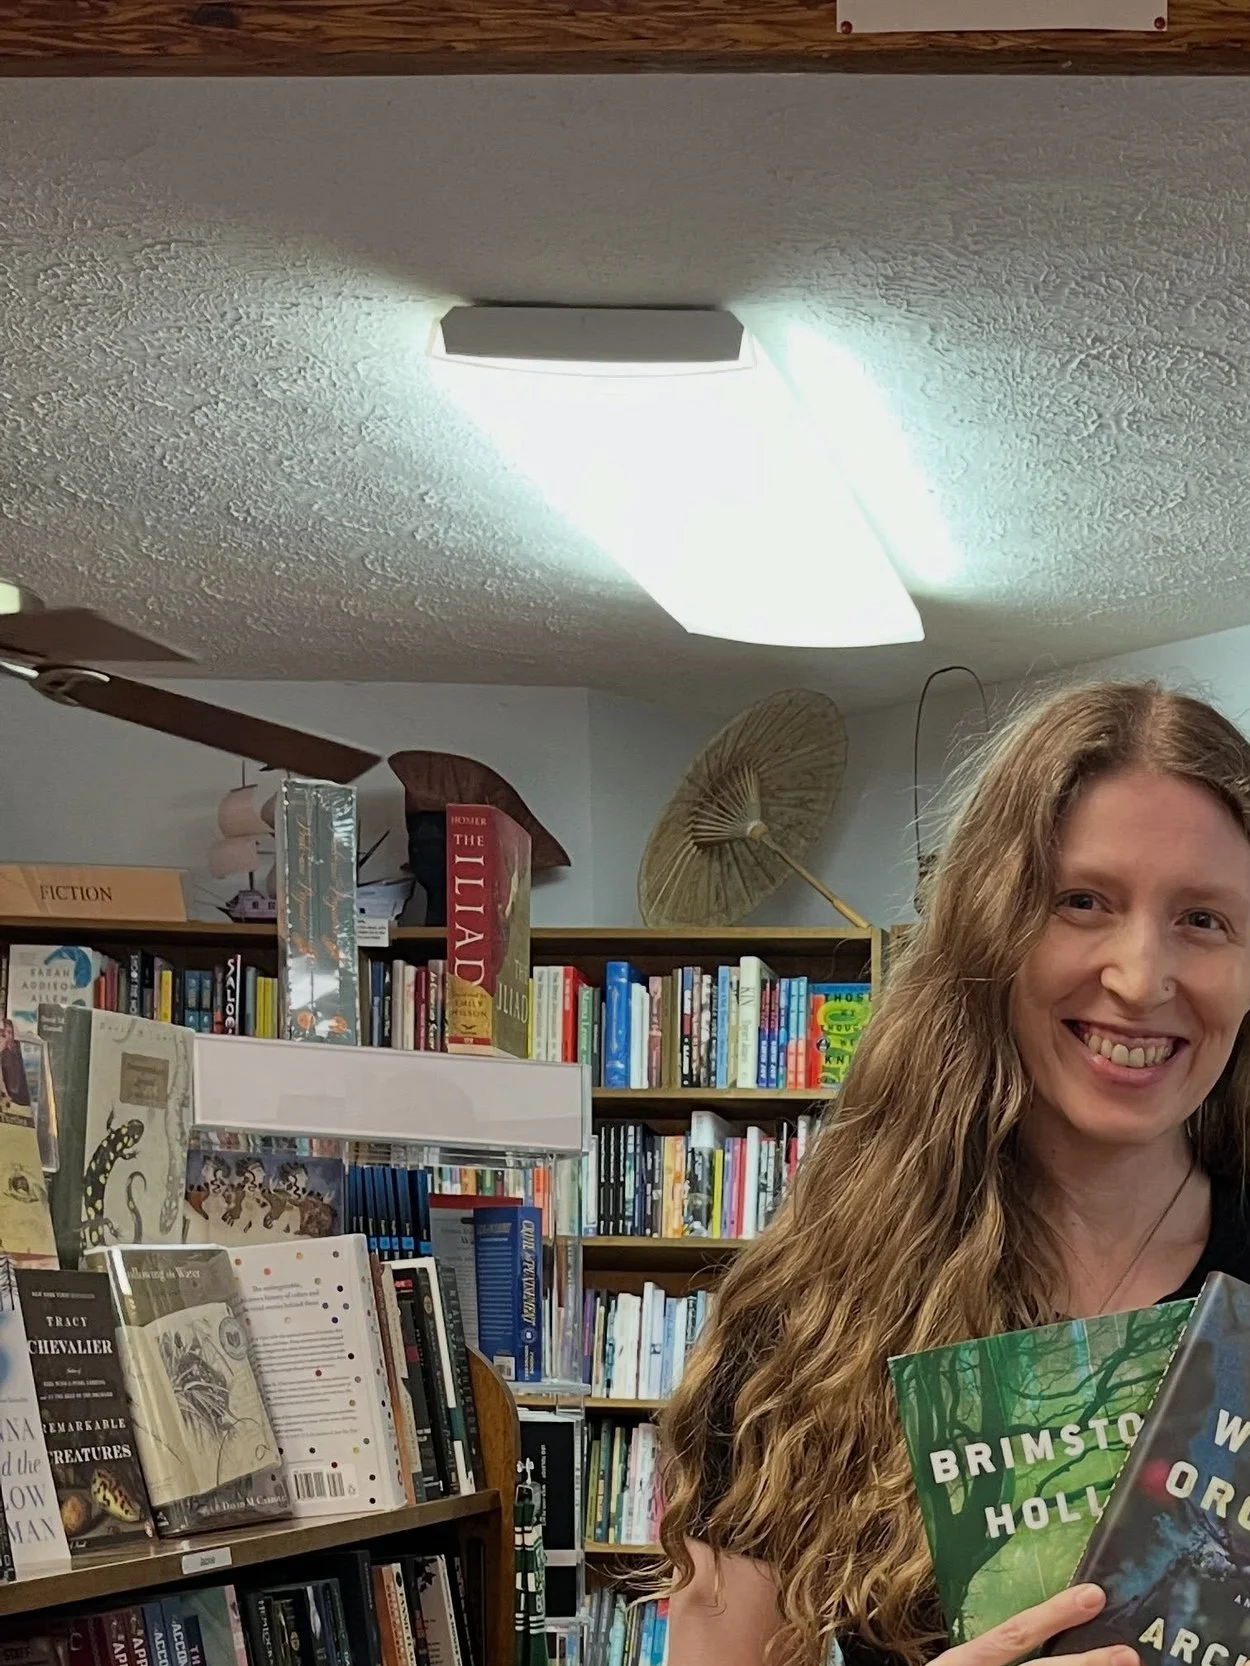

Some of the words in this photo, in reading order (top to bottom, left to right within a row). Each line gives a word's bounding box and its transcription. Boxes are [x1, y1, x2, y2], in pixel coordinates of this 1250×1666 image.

[451, 816, 487, 827] HOMER
[453, 834, 485, 847] THE
[39, 884, 113, 902] FICTION
[454, 854, 485, 988] ILIAD
[46, 1316, 88, 1328] TRACY
[27, 1339, 113, 1355] CHEVALIER
[18, 1451, 41, 1475] the
[1234, 1594, 1242, 1605] A
[257, 1600, 274, 1656] HEMLOCK
